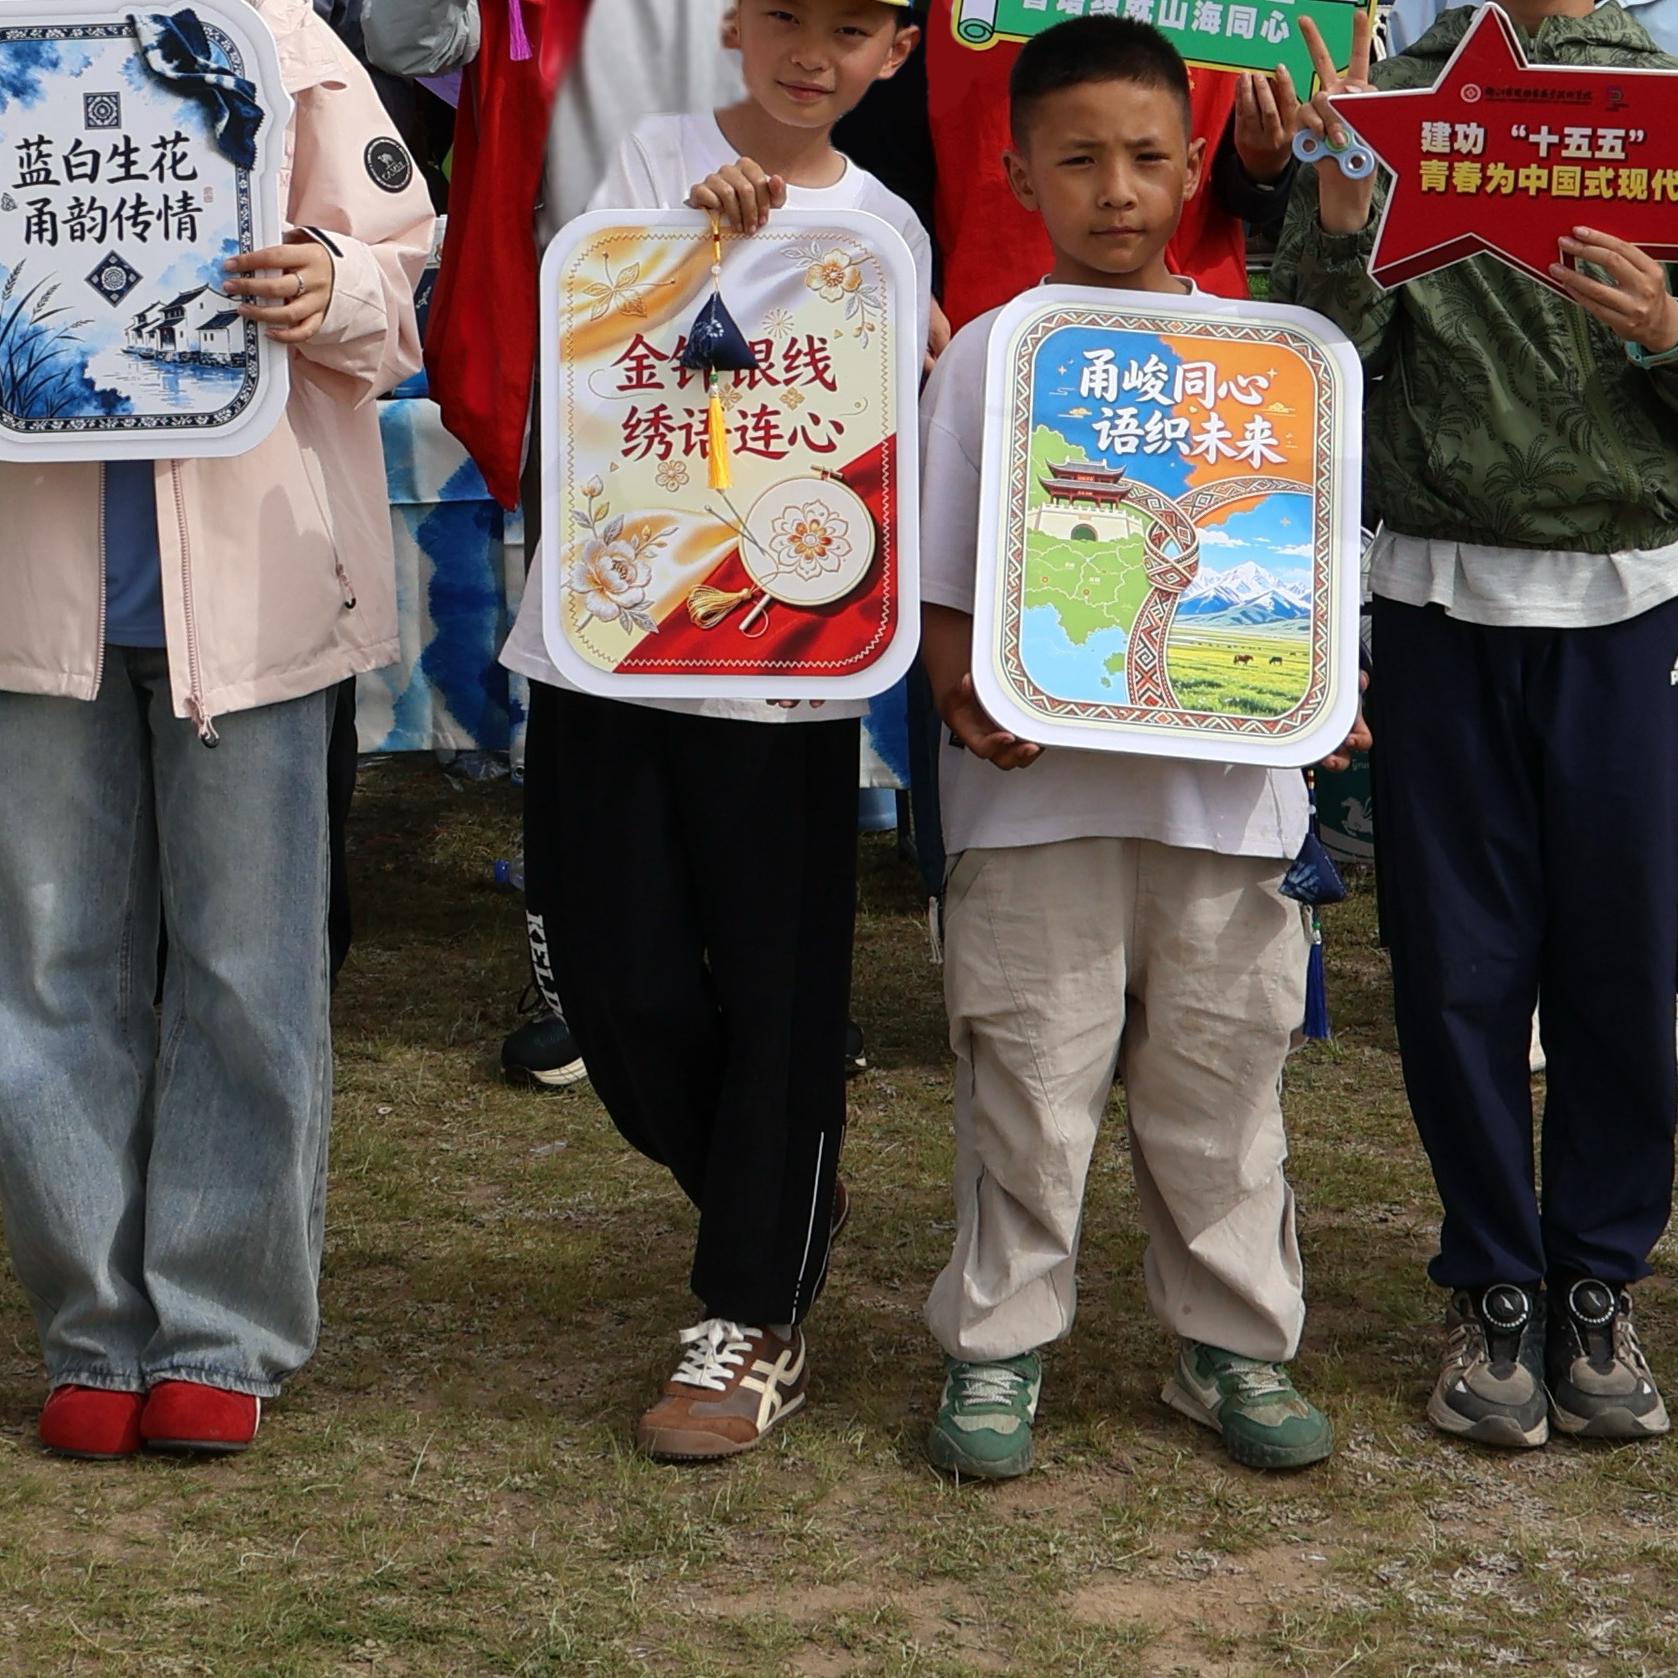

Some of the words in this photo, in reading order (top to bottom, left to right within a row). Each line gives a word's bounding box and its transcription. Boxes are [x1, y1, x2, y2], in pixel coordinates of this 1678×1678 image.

[12, 130, 200, 191] 蓝白生花
[1421, 121, 1485, 156] 建功
[22, 190, 204, 248] 甬韵传情
[1079, 348, 1270, 410] 甬峻同心
[620, 403, 845, 462] 绣语连心
[1091, 407, 1287, 469] 语织未来
